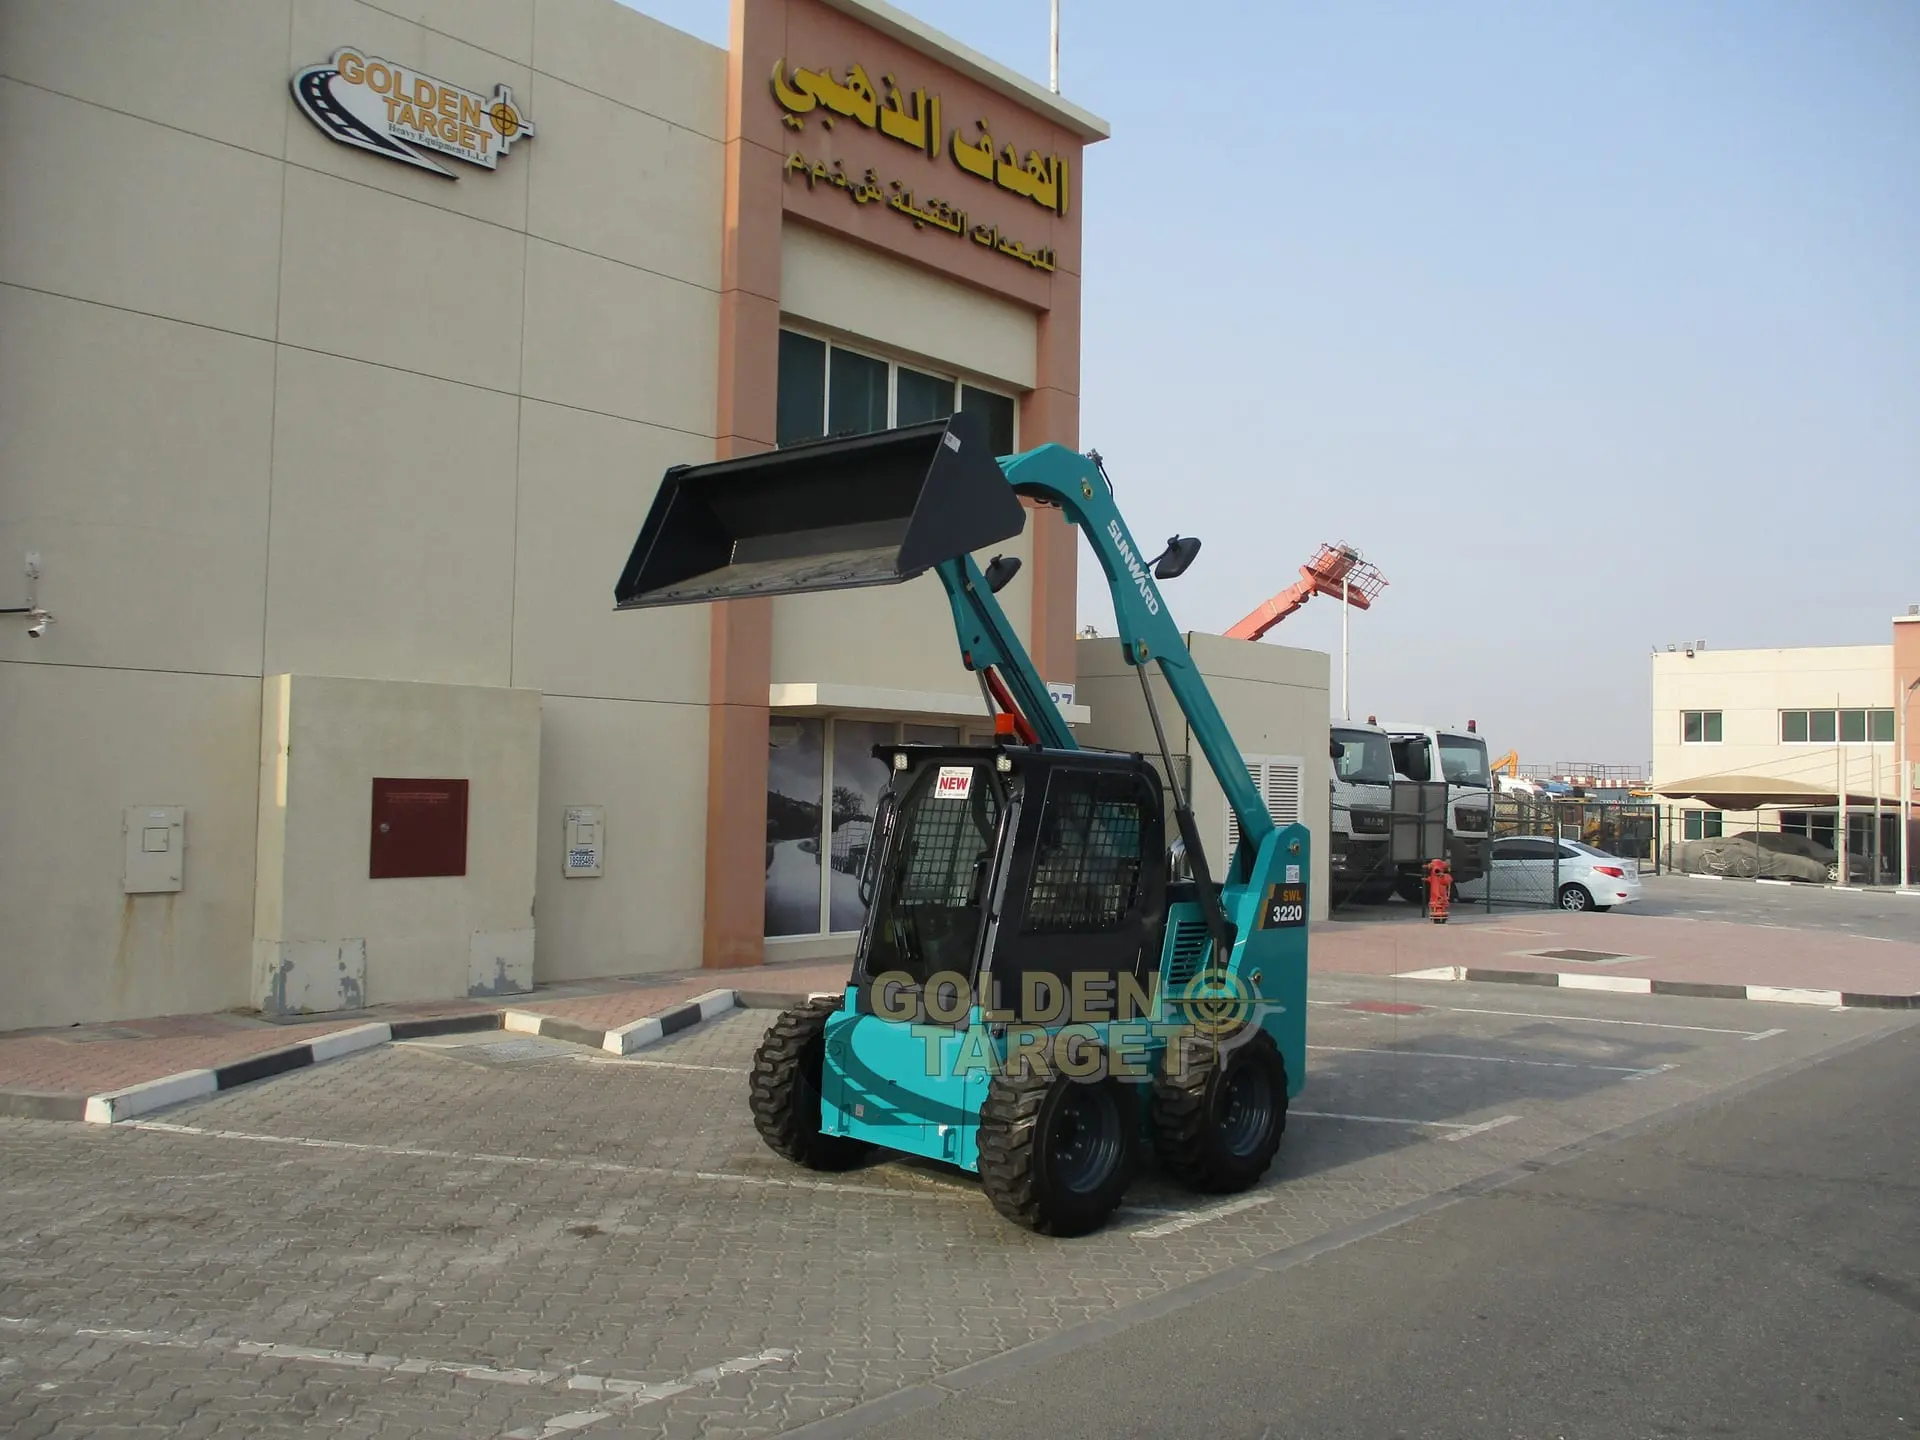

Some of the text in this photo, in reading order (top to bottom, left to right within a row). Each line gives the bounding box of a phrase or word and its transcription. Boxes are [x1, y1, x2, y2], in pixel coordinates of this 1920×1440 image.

[337, 52, 482, 128] GOLDEN
[382, 95, 494, 155] TARGET
[388, 122, 415, 140] Heavy
[418, 133, 466, 155] Equipment
[769, 56, 1069, 217] الهدف الذهبي
[887, 179, 969, 238] الثقيلة
[970, 222, 1057, 272] للمعدات
[1106, 519, 1160, 616] SUNWARD
[939, 776, 969, 790] NEW
[1272, 904, 1303, 922] 3220
[1283, 889, 1303, 902] SWL
